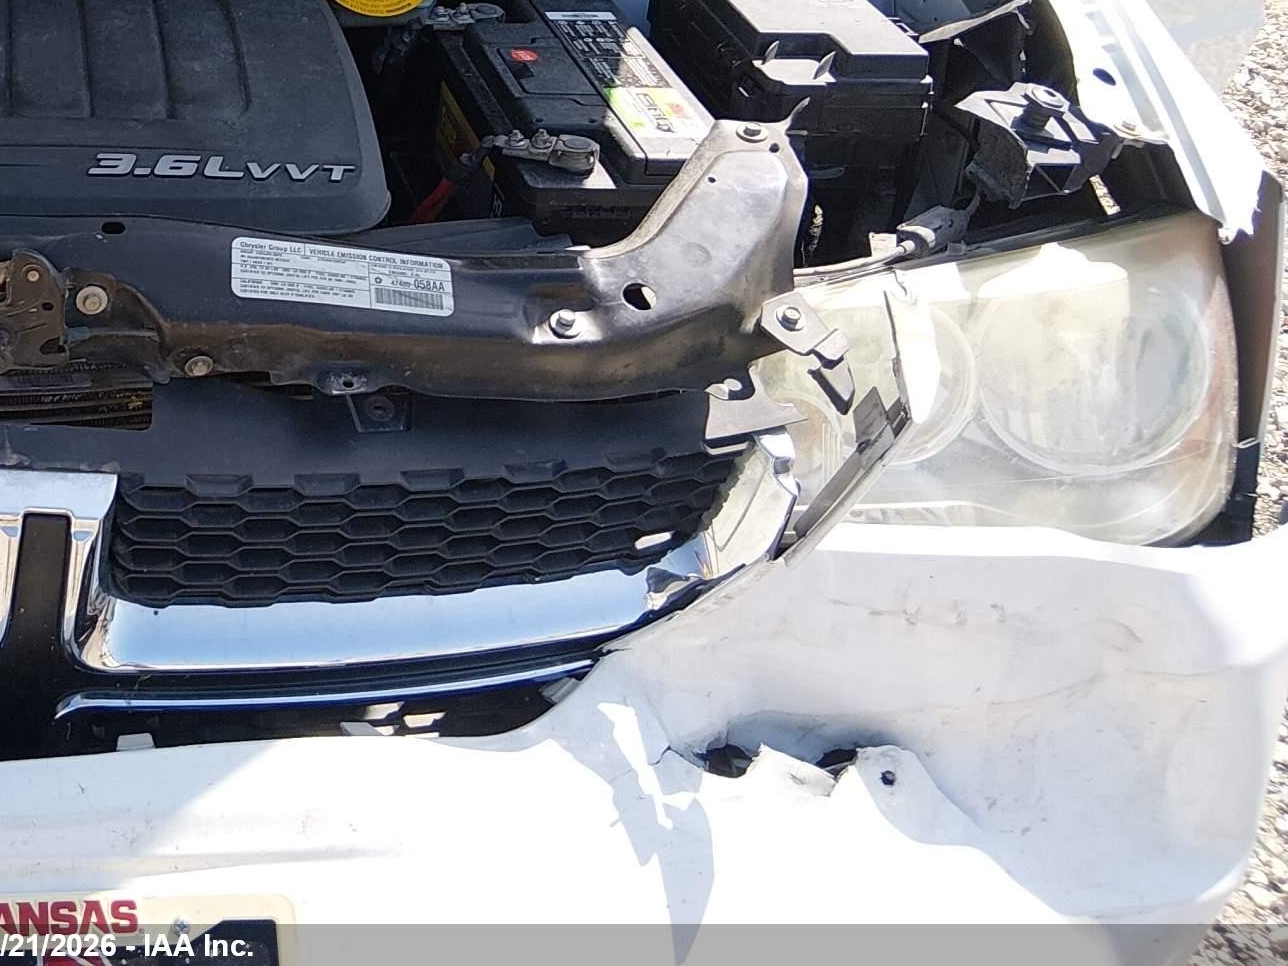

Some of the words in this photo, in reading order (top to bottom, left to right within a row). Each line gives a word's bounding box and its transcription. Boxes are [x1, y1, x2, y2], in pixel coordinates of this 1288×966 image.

[240, 241, 266, 250] Chrysler
[268, 244, 288, 253] Group
[309, 248, 335, 257] VEHICLE
[337, 251, 367, 261] EMISSION
[368, 255, 398, 264] CONTROL
[399, 258, 444, 269] INFORMATION
